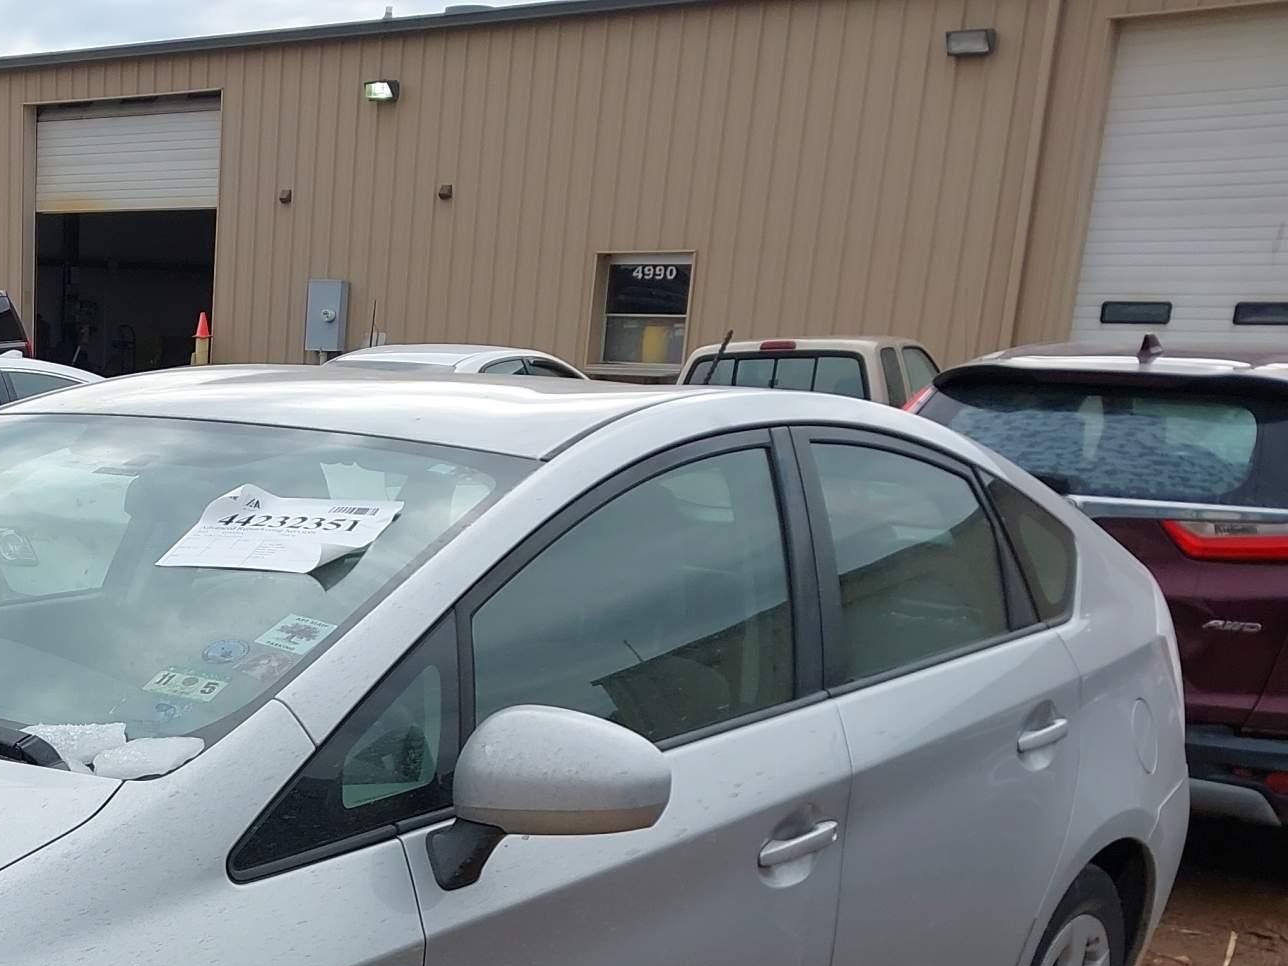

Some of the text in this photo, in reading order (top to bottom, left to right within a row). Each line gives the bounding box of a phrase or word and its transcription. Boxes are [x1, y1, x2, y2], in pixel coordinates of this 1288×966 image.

[632, 265, 677, 280] 4990
[218, 513, 361, 532] 44232351
[200, 682, 219, 695] 5
